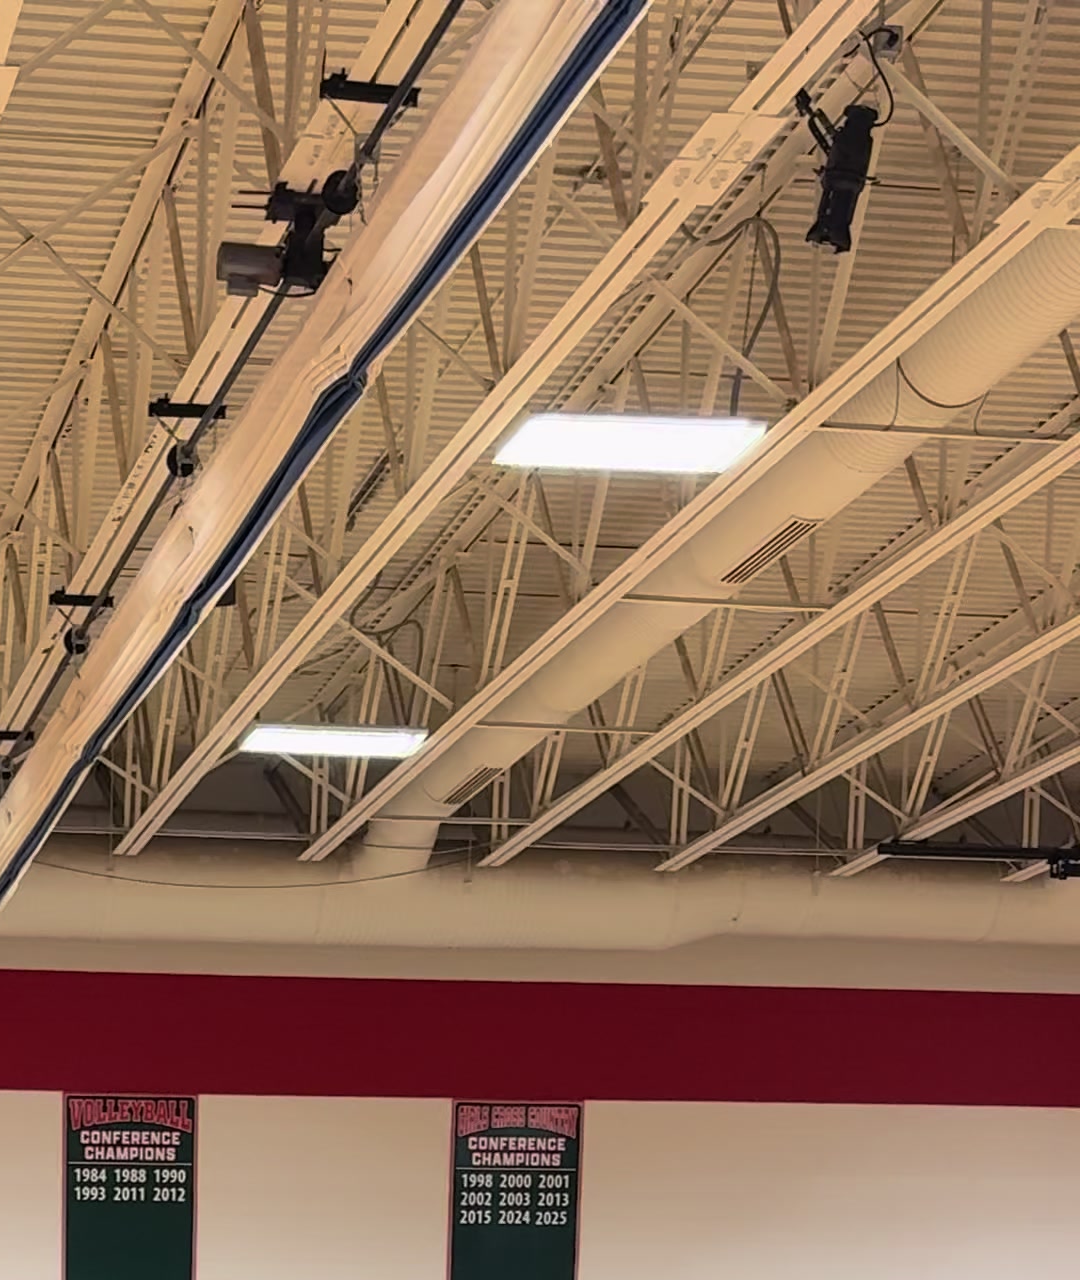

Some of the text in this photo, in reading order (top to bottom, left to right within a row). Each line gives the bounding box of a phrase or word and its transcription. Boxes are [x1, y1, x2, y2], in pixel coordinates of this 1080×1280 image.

[70, 1099, 192, 1133] VOLLEYBALL
[80, 1130, 181, 1145] CONFERENCE
[468, 1137, 566, 1151] CONFERENCE
[84, 1146, 176, 1161] CHAMPIONS
[472, 1152, 561, 1166] CHAMPIONS
[74, 1168, 186, 1183] 1984 1988 1990
[461, 1174, 570, 1188] 1998 2000 2001
[74, 1187, 186, 1202] 1993 2011 2012
[460, 1192, 569, 1207] 2002 2003 2013
[460, 1210, 567, 1225] 2015 2024 2025
